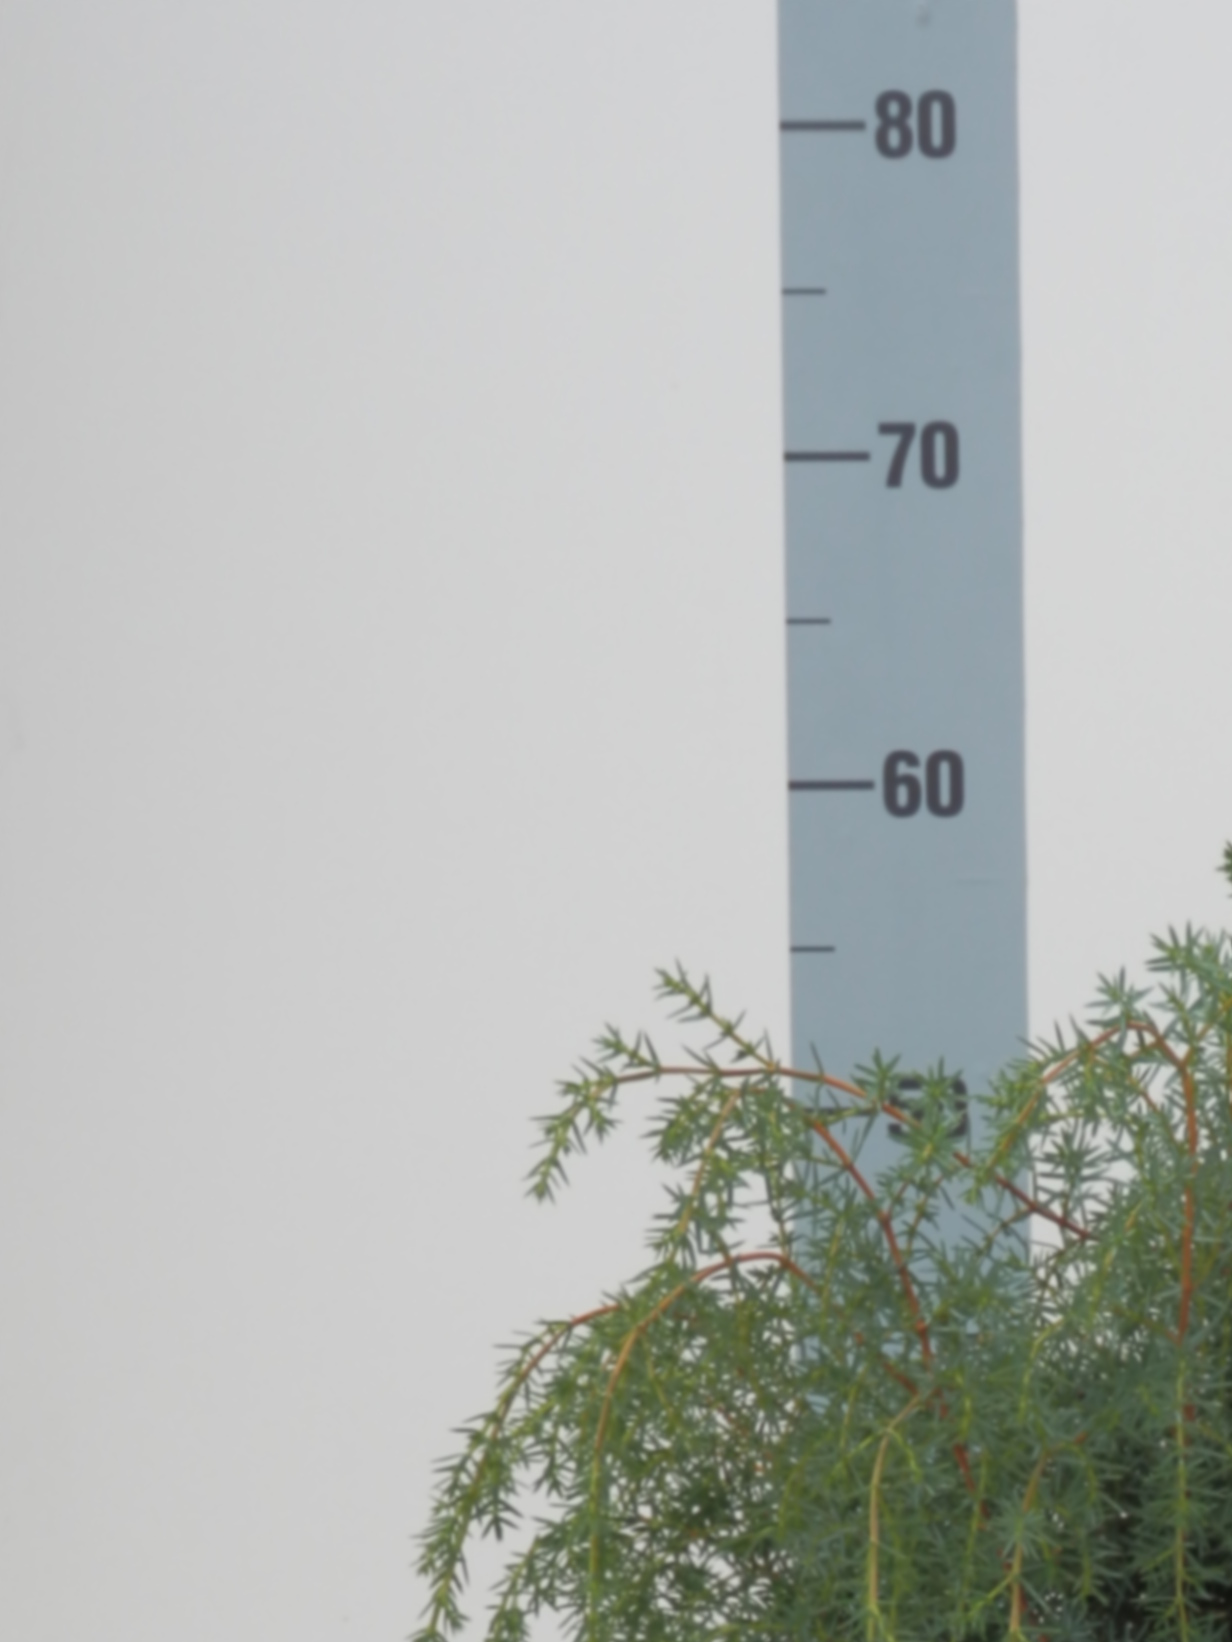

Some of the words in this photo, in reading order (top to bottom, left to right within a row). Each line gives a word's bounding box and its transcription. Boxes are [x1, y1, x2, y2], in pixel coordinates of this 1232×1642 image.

[874, 89, 956, 159] 80
[878, 420, 960, 489] 70
[882, 749, 965, 818] 60
